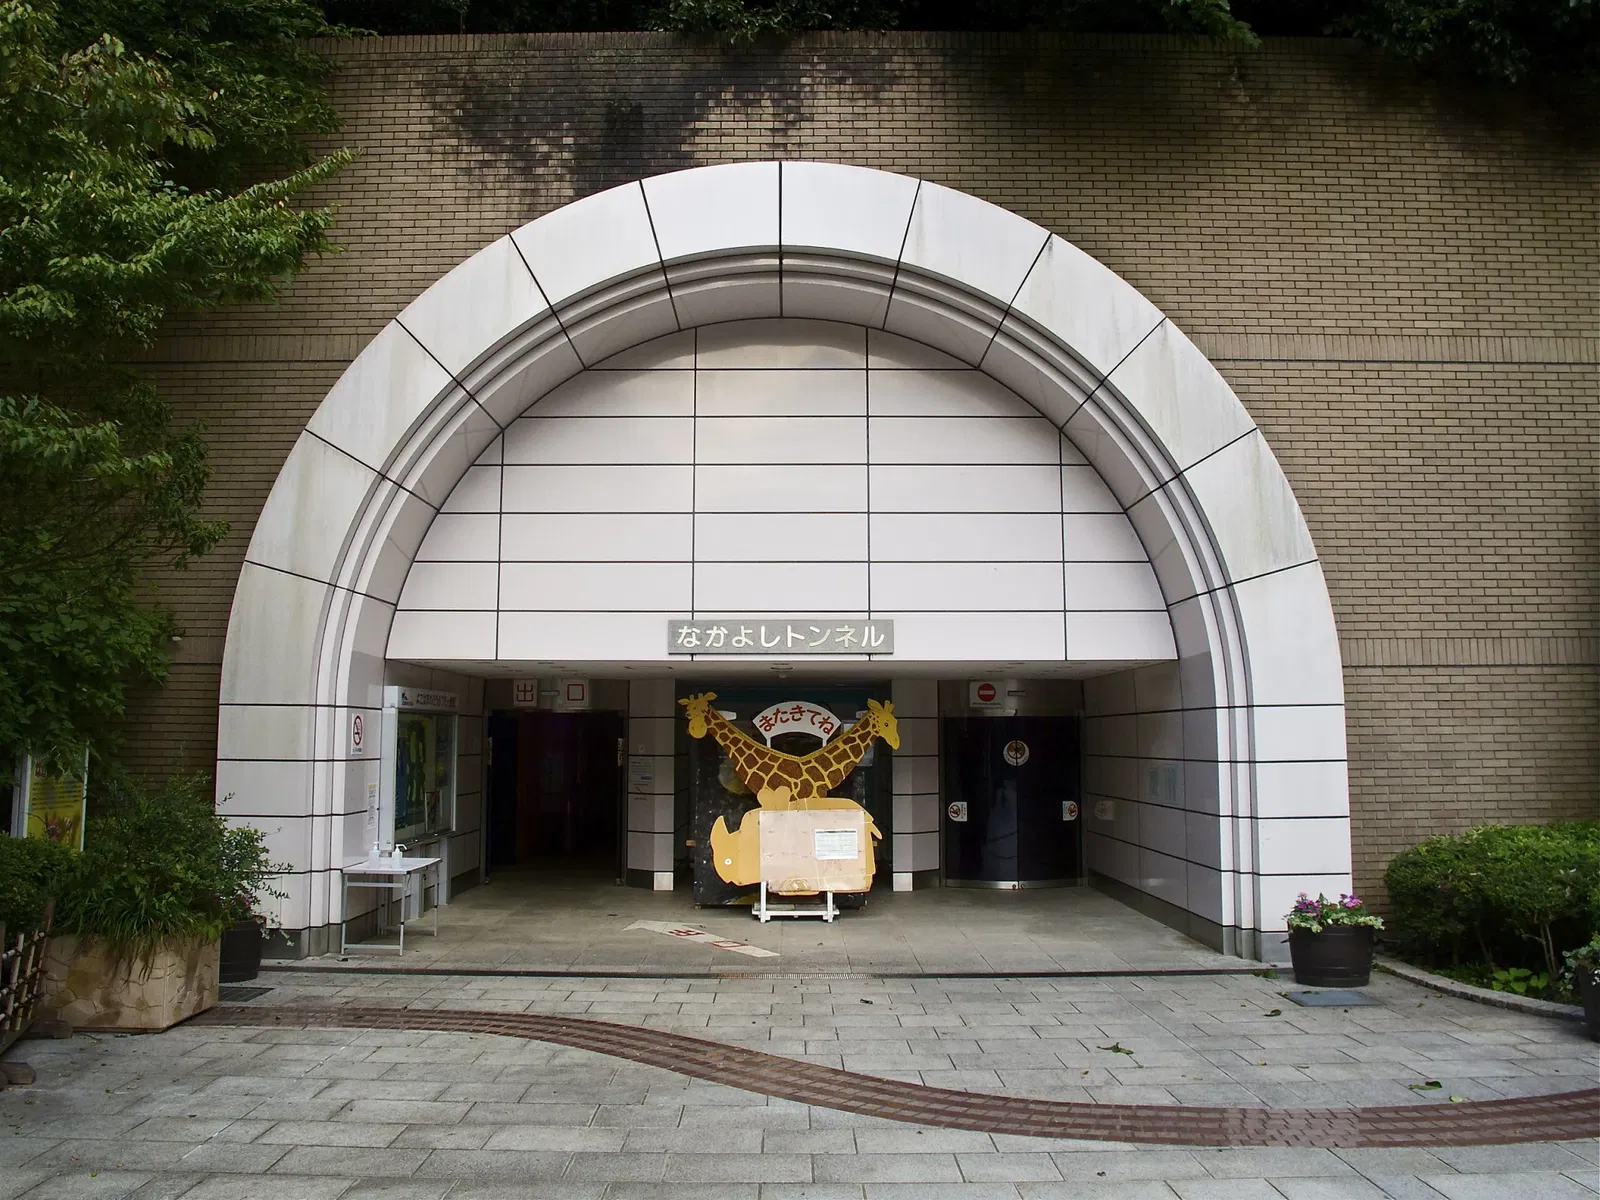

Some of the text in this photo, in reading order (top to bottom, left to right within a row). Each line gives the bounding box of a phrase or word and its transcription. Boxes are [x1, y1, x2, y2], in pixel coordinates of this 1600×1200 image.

[677, 625, 885, 648] なかよしトンネル
[517, 683, 584, 701] 出口
[759, 705, 834, 735] またきてね
[667, 929, 749, 948] 出口
